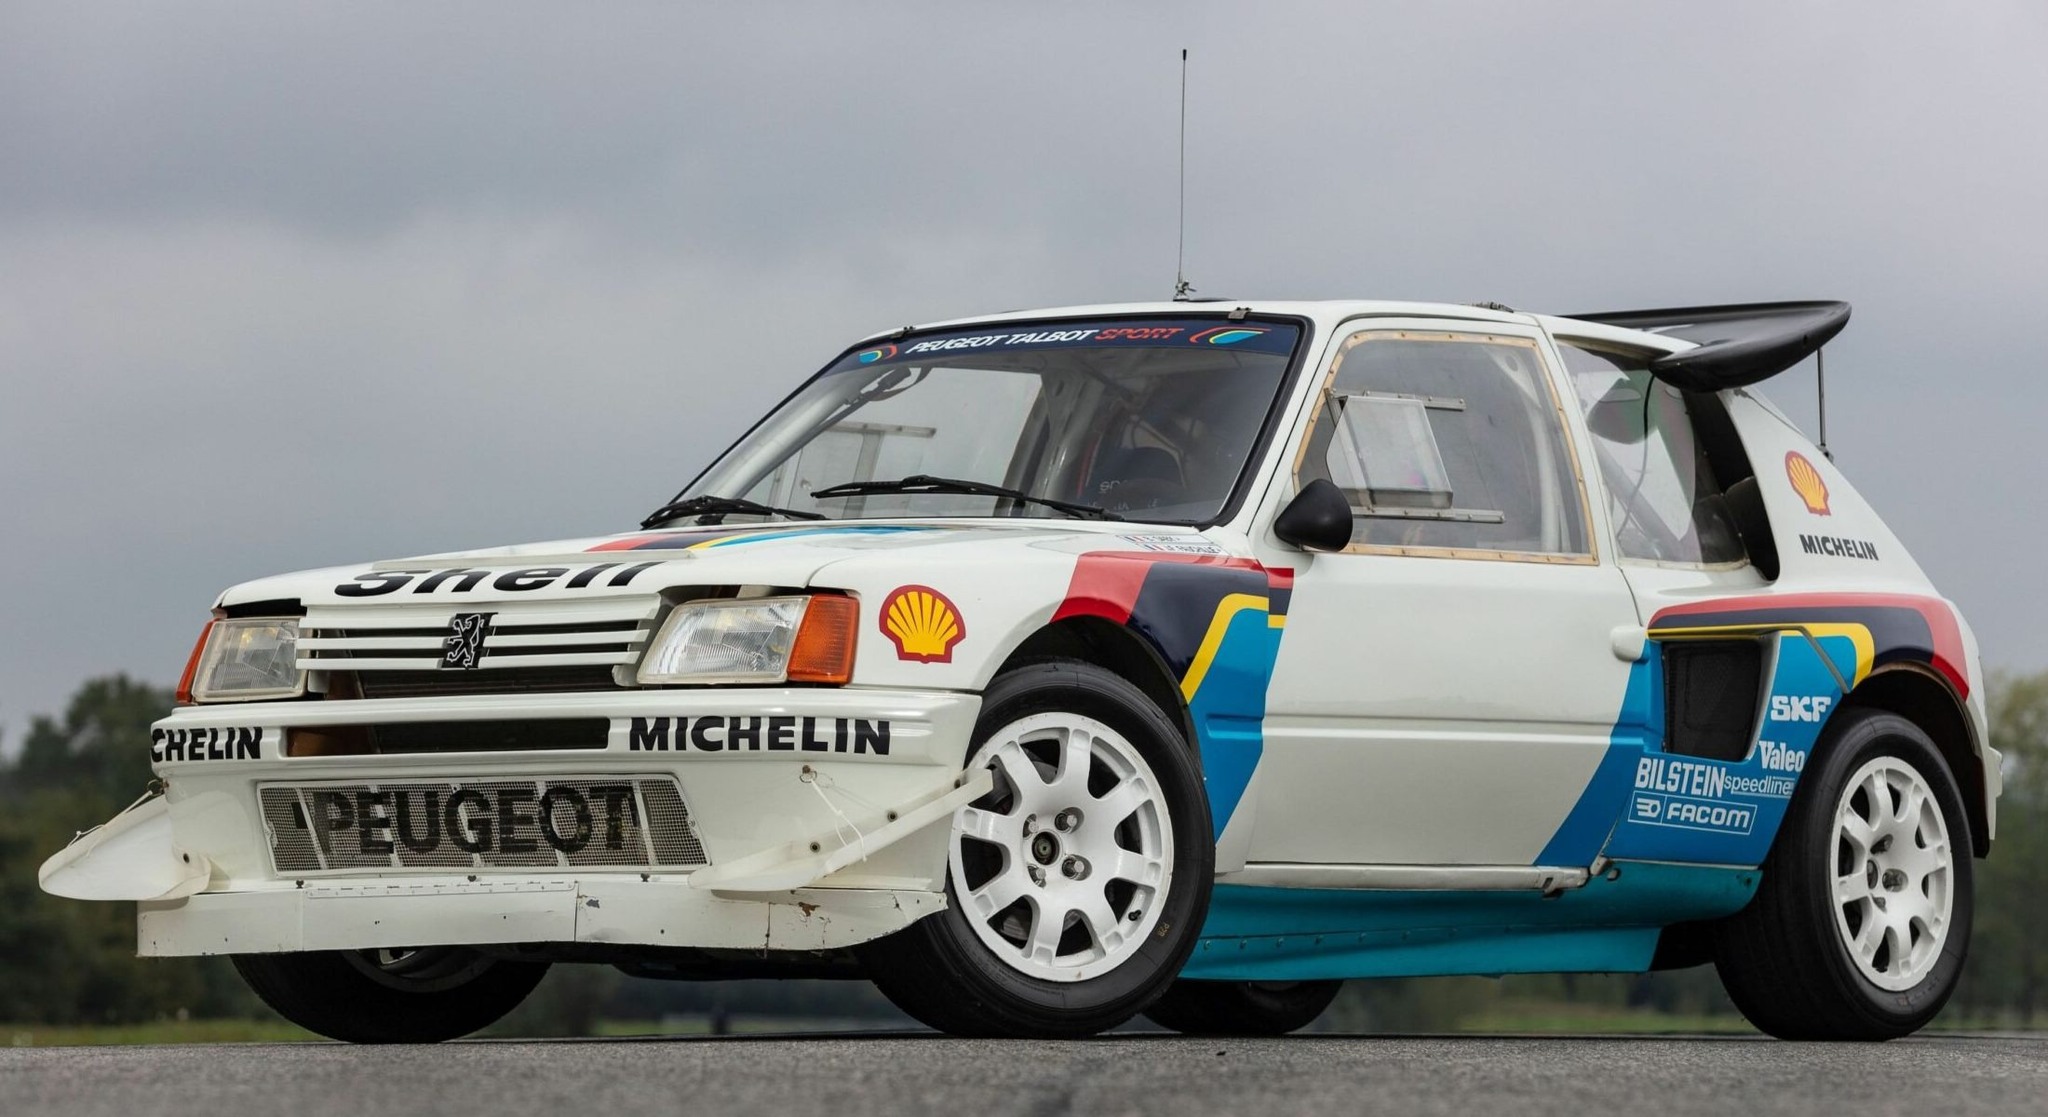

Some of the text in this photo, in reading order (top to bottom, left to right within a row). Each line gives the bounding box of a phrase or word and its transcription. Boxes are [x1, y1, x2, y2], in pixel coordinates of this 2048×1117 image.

[906, 328, 1184, 354] PEUGEOT TALBOT SPORT
[1799, 534, 1879, 561] MICHELIN
[334, 561, 666, 597] Shell
[1770, 695, 1832, 722] SKF
[630, 716, 891, 756] MICHELIN
[1758, 740, 1805, 773] Valeo
[1634, 757, 1726, 798] BILSTEIN
[312, 785, 637, 856] PEUGEOT
[1666, 802, 1751, 828] FACOM
